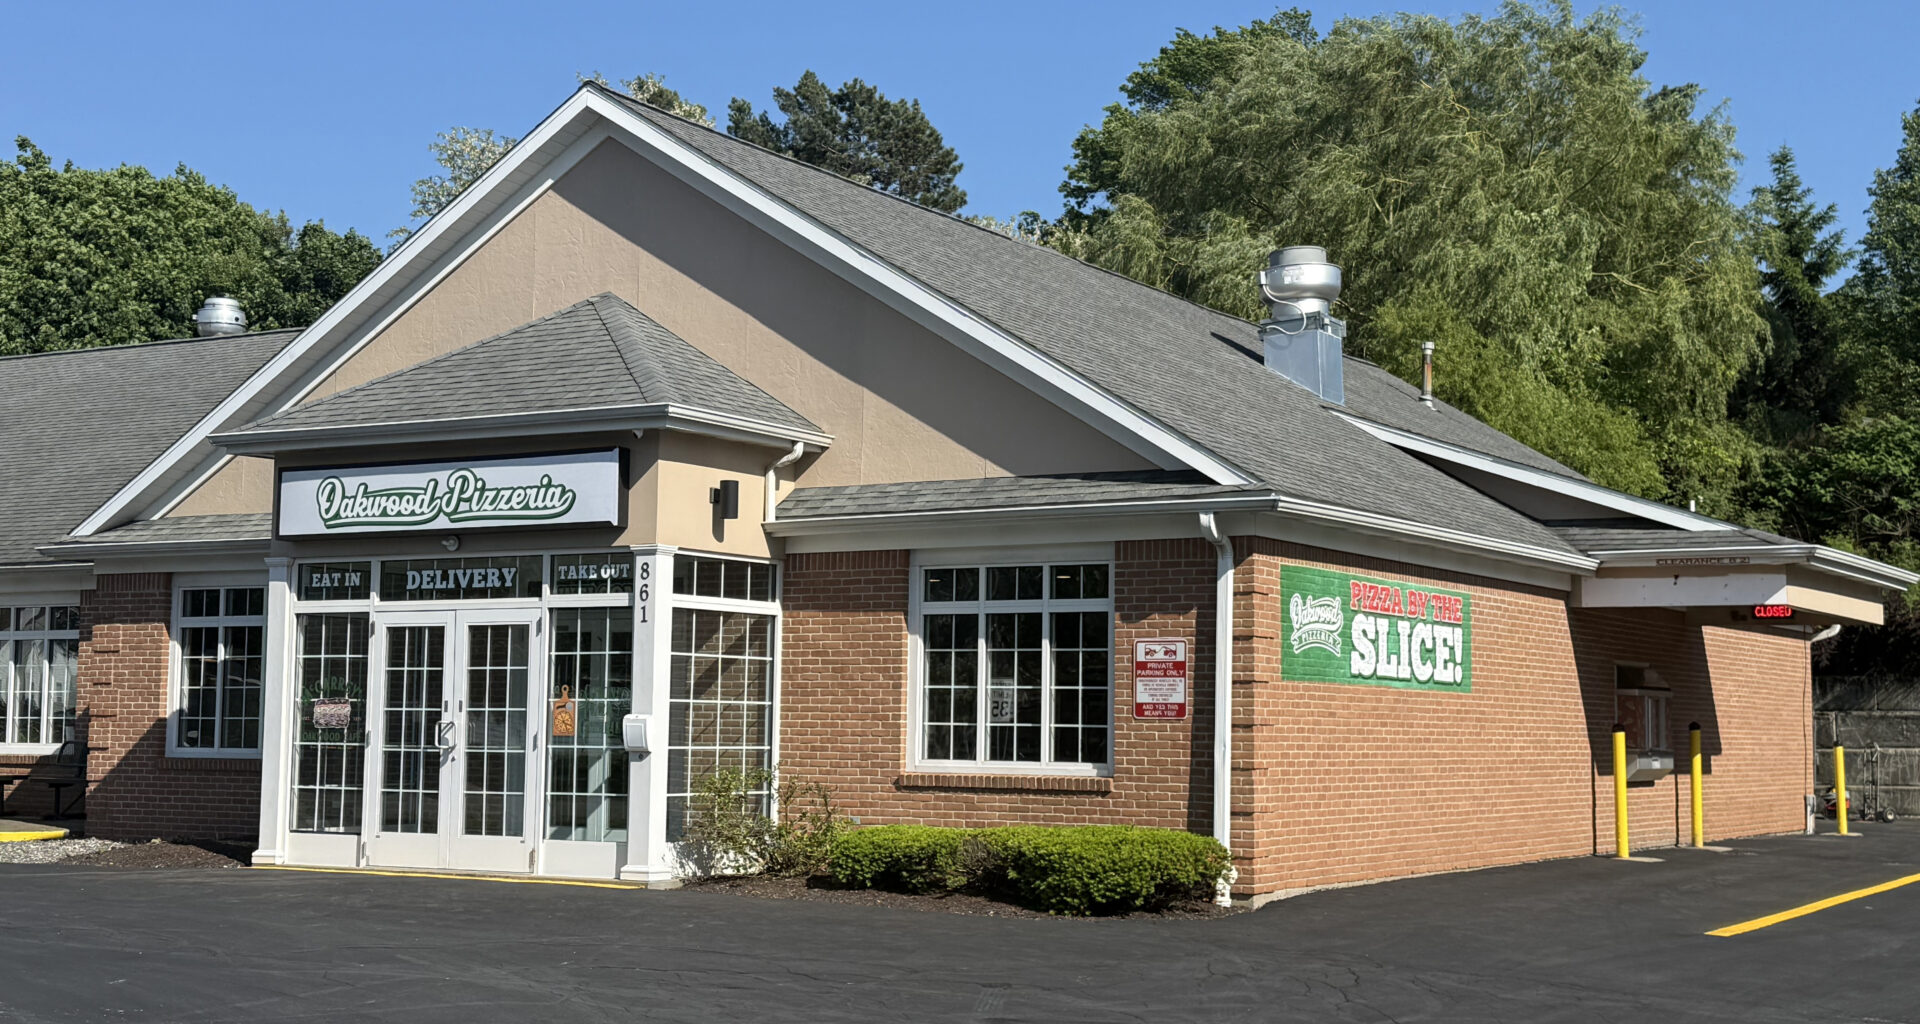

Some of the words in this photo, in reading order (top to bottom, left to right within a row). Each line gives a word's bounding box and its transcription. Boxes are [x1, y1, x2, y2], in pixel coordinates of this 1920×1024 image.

[317, 476, 442, 529] Oakwood
[442, 468, 576, 522] Pizzeria
[312, 573, 341, 588] EAT
[344, 572, 361, 587] IN
[406, 567, 518, 590] DELIVERY
[558, 564, 597, 580] TAKE
[600, 563, 630, 579] OUT
[639, 561, 651, 624] 861
[1350, 580, 1404, 617] PIZZA
[1406, 590, 1430, 620] BY
[1430, 593, 1463, 624] THE
[1290, 592, 1343, 632] Oakwood
[1754, 605, 1792, 617] CLOSED
[1301, 630, 1335, 645] PIZZERIA
[1350, 613, 1463, 685] SLICE!
[302, 732, 340, 741] OAKOOD
